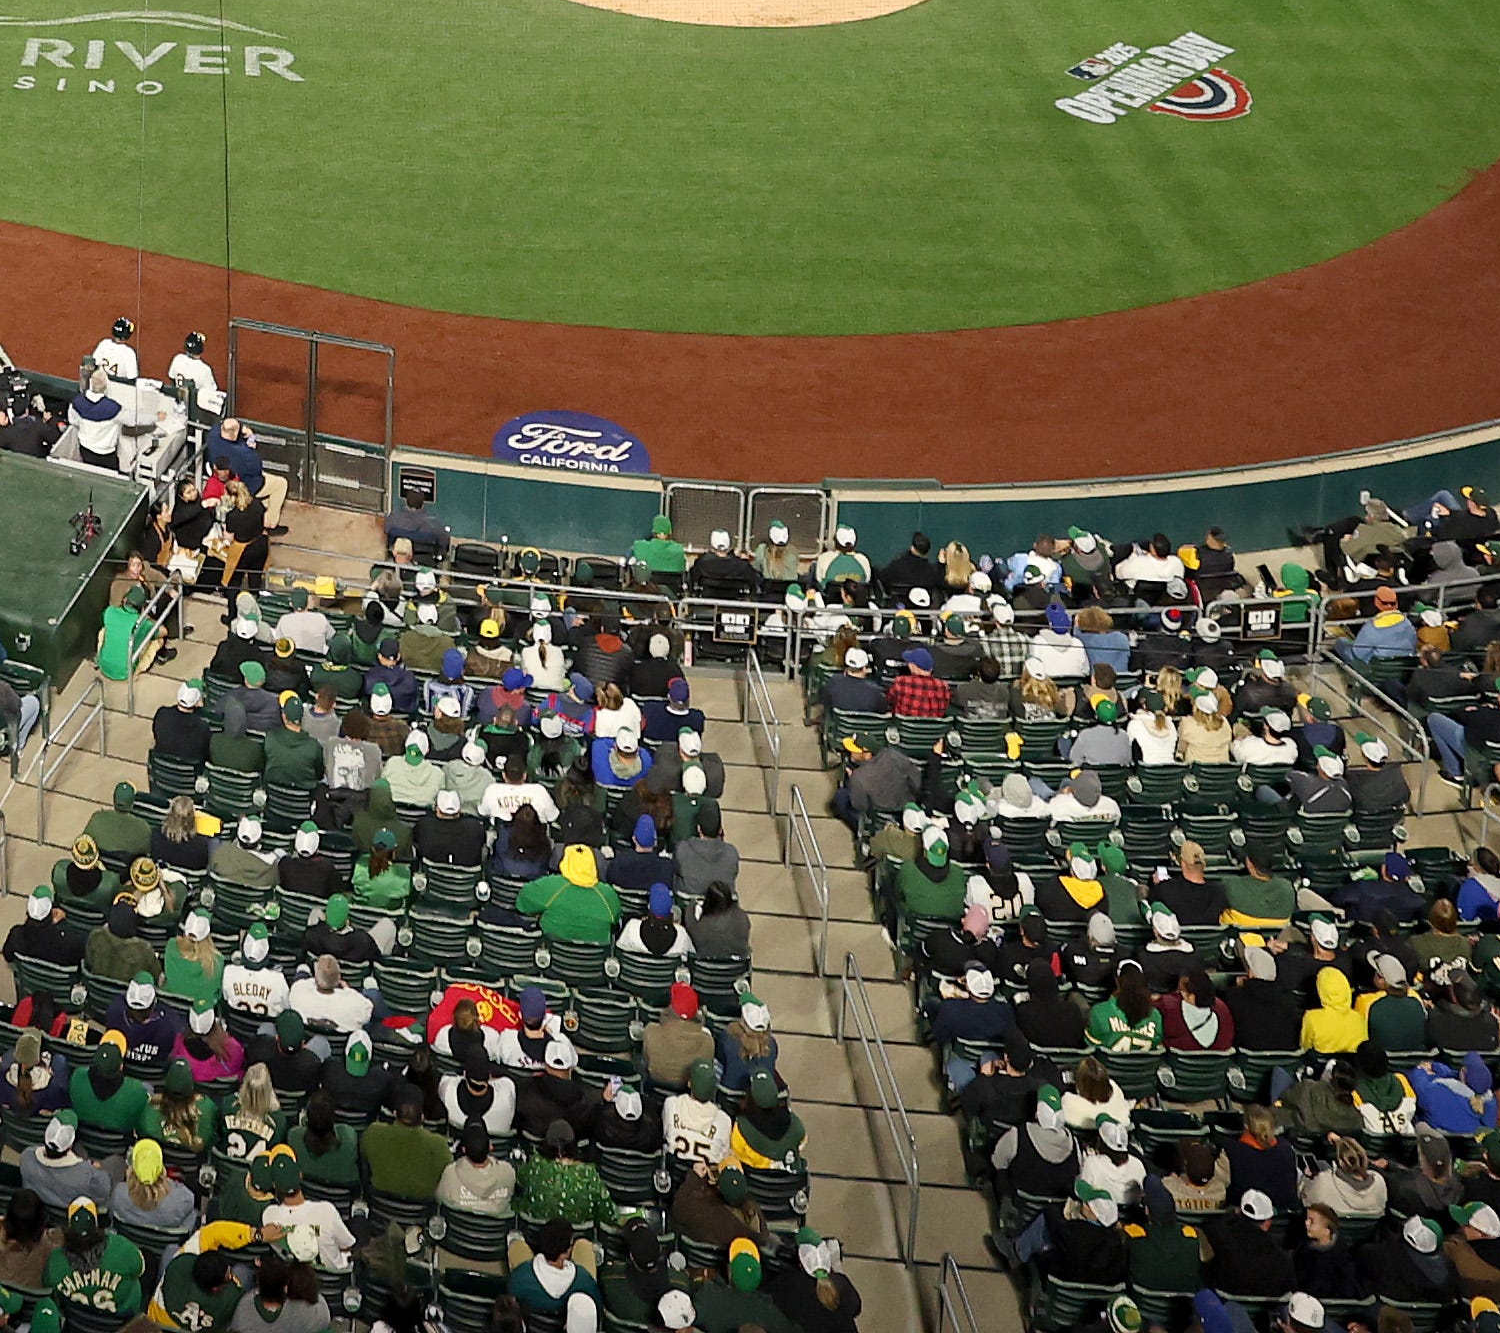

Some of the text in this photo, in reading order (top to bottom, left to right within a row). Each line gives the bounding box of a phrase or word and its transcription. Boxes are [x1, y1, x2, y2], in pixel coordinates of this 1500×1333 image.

[21, 36, 304, 81] RIVER
[1055, 31, 1236, 124] OPENING DAY
[103, 358, 118, 376] 24
[508, 423, 633, 462] Ford
[520, 454, 620, 473] CALIFORNIA
[233, 982, 271, 1000] BLEDAY
[228, 1132, 268, 1163] 24
[674, 1136, 712, 1167] 25
[57, 1268, 122, 1296] CHAPMAN
